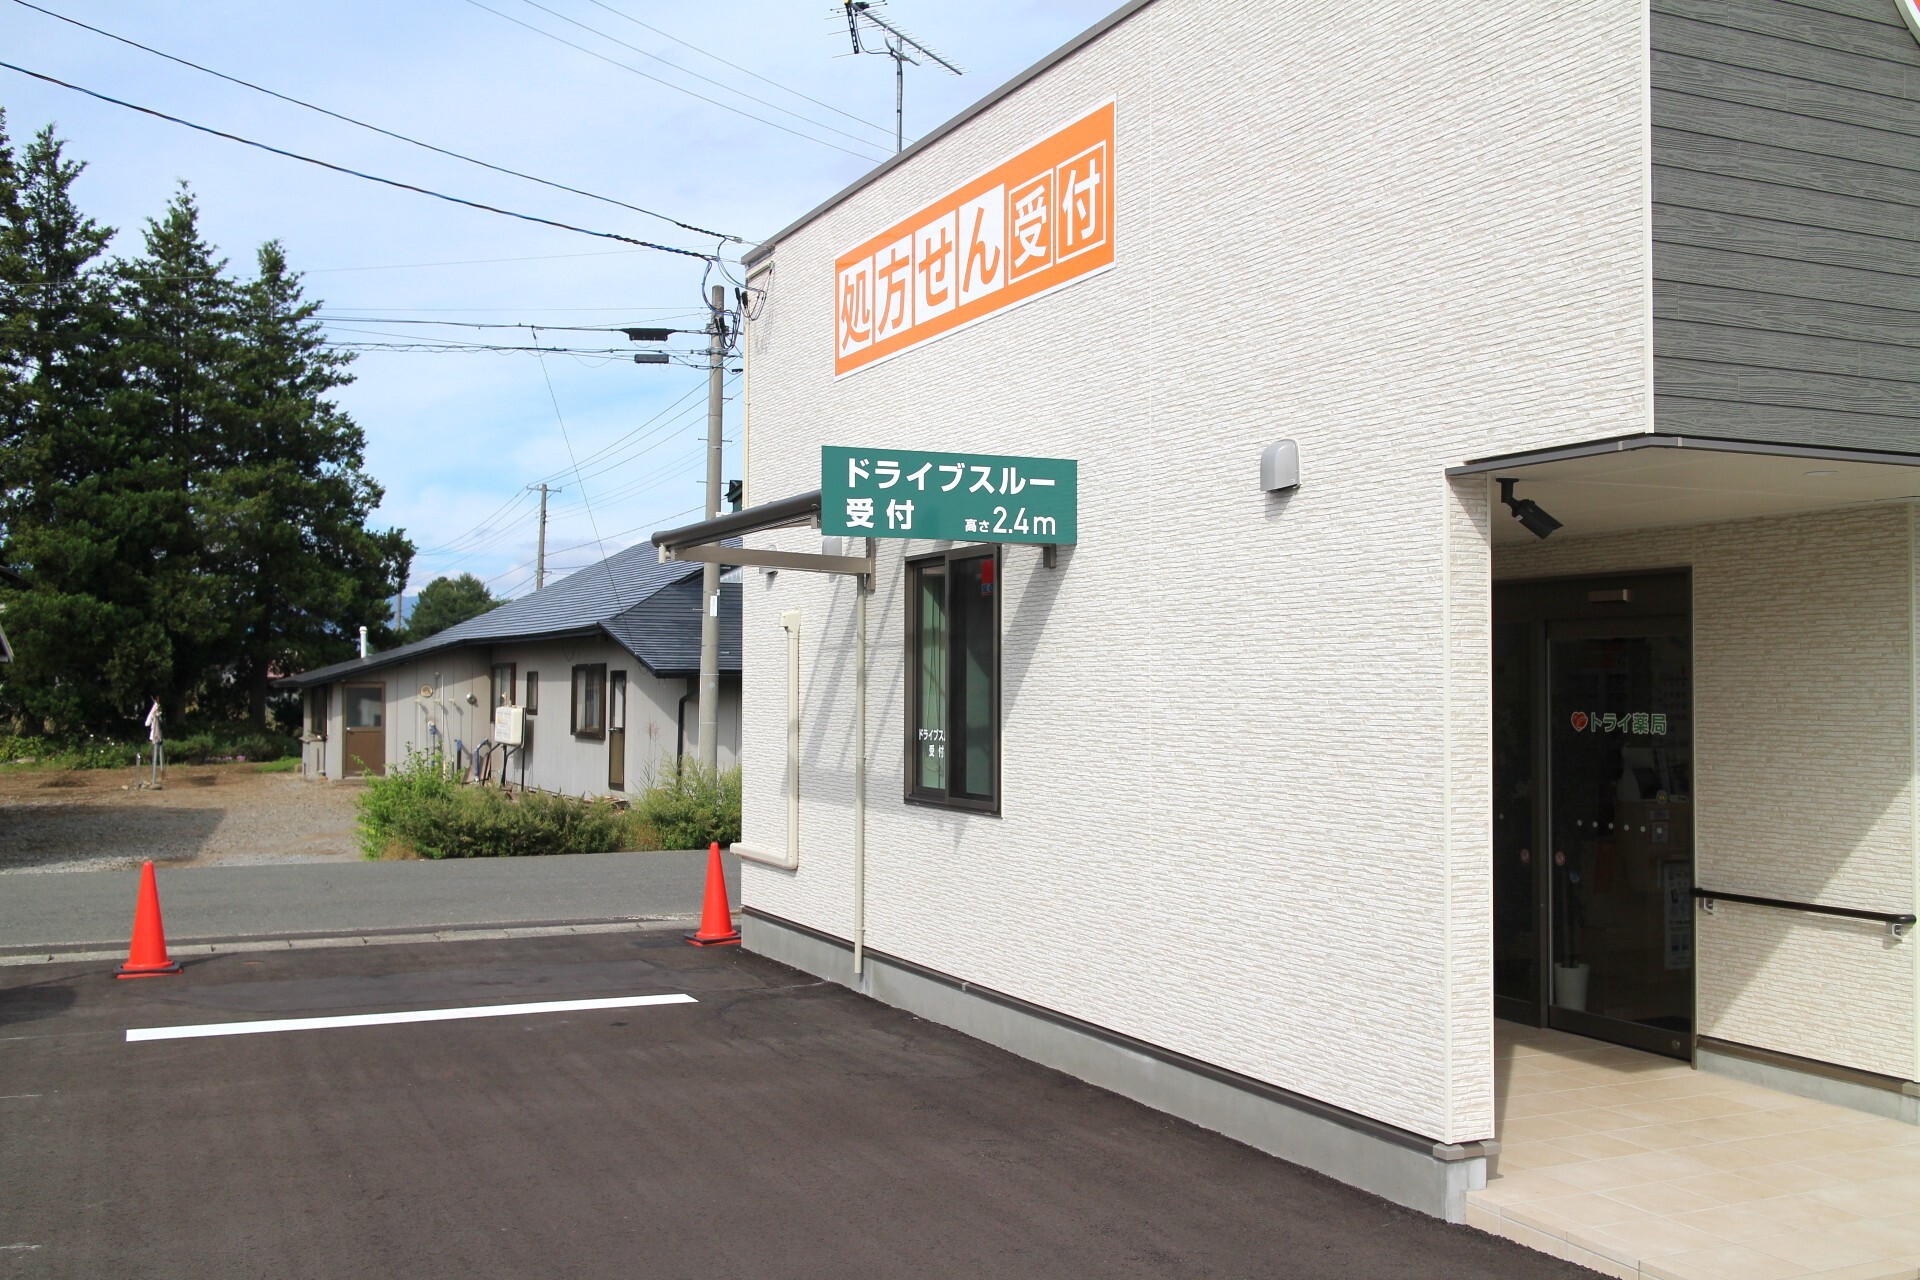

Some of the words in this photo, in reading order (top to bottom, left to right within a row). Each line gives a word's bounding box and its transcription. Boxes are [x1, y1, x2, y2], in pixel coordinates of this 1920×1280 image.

[841, 157, 1101, 350] 処方せん受付
[848, 457, 1056, 495] ドライブスルー
[846, 497, 915, 530] 受付
[1590, 711, 1667, 735] トライ薬局
